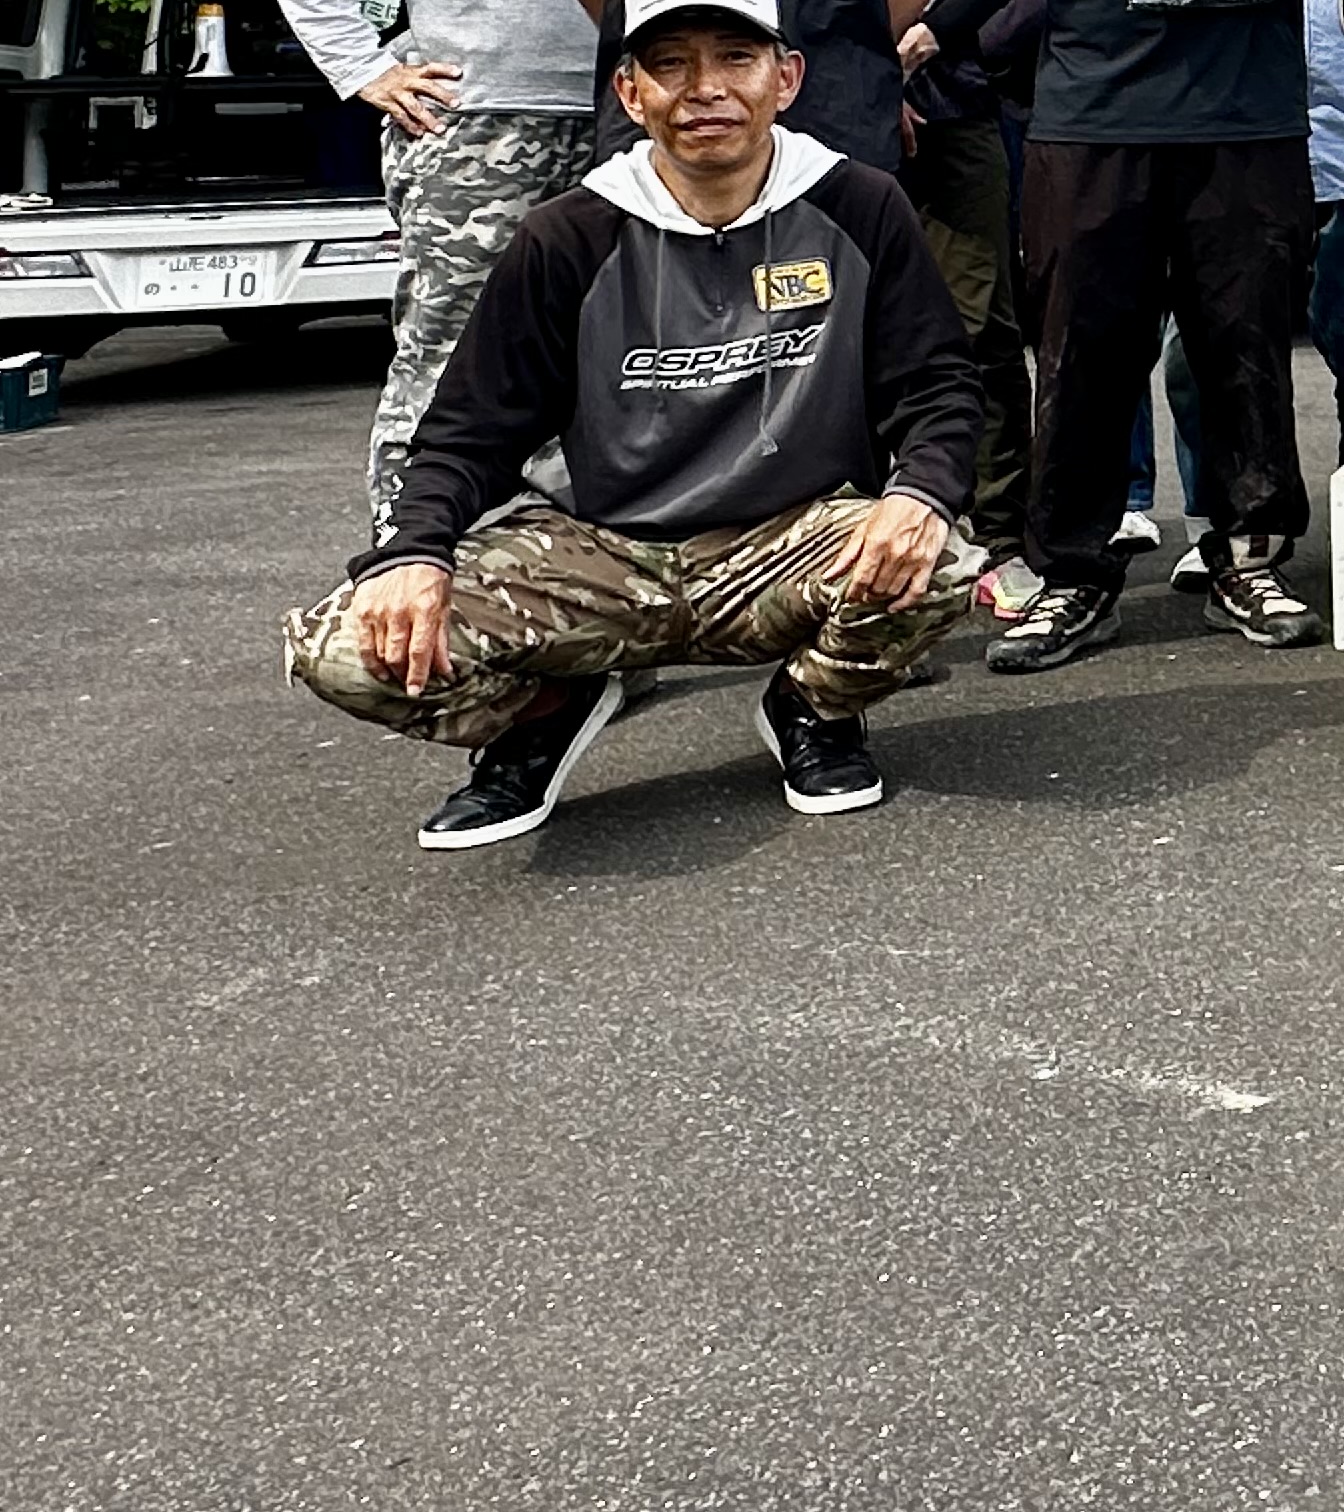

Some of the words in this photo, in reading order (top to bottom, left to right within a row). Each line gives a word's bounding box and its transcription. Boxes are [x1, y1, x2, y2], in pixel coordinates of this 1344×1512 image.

[207, 255, 239, 270] 483
[223, 272, 257, 298] 10
[761, 269, 823, 298] NBC
[621, 322, 826, 376] OSPREY
